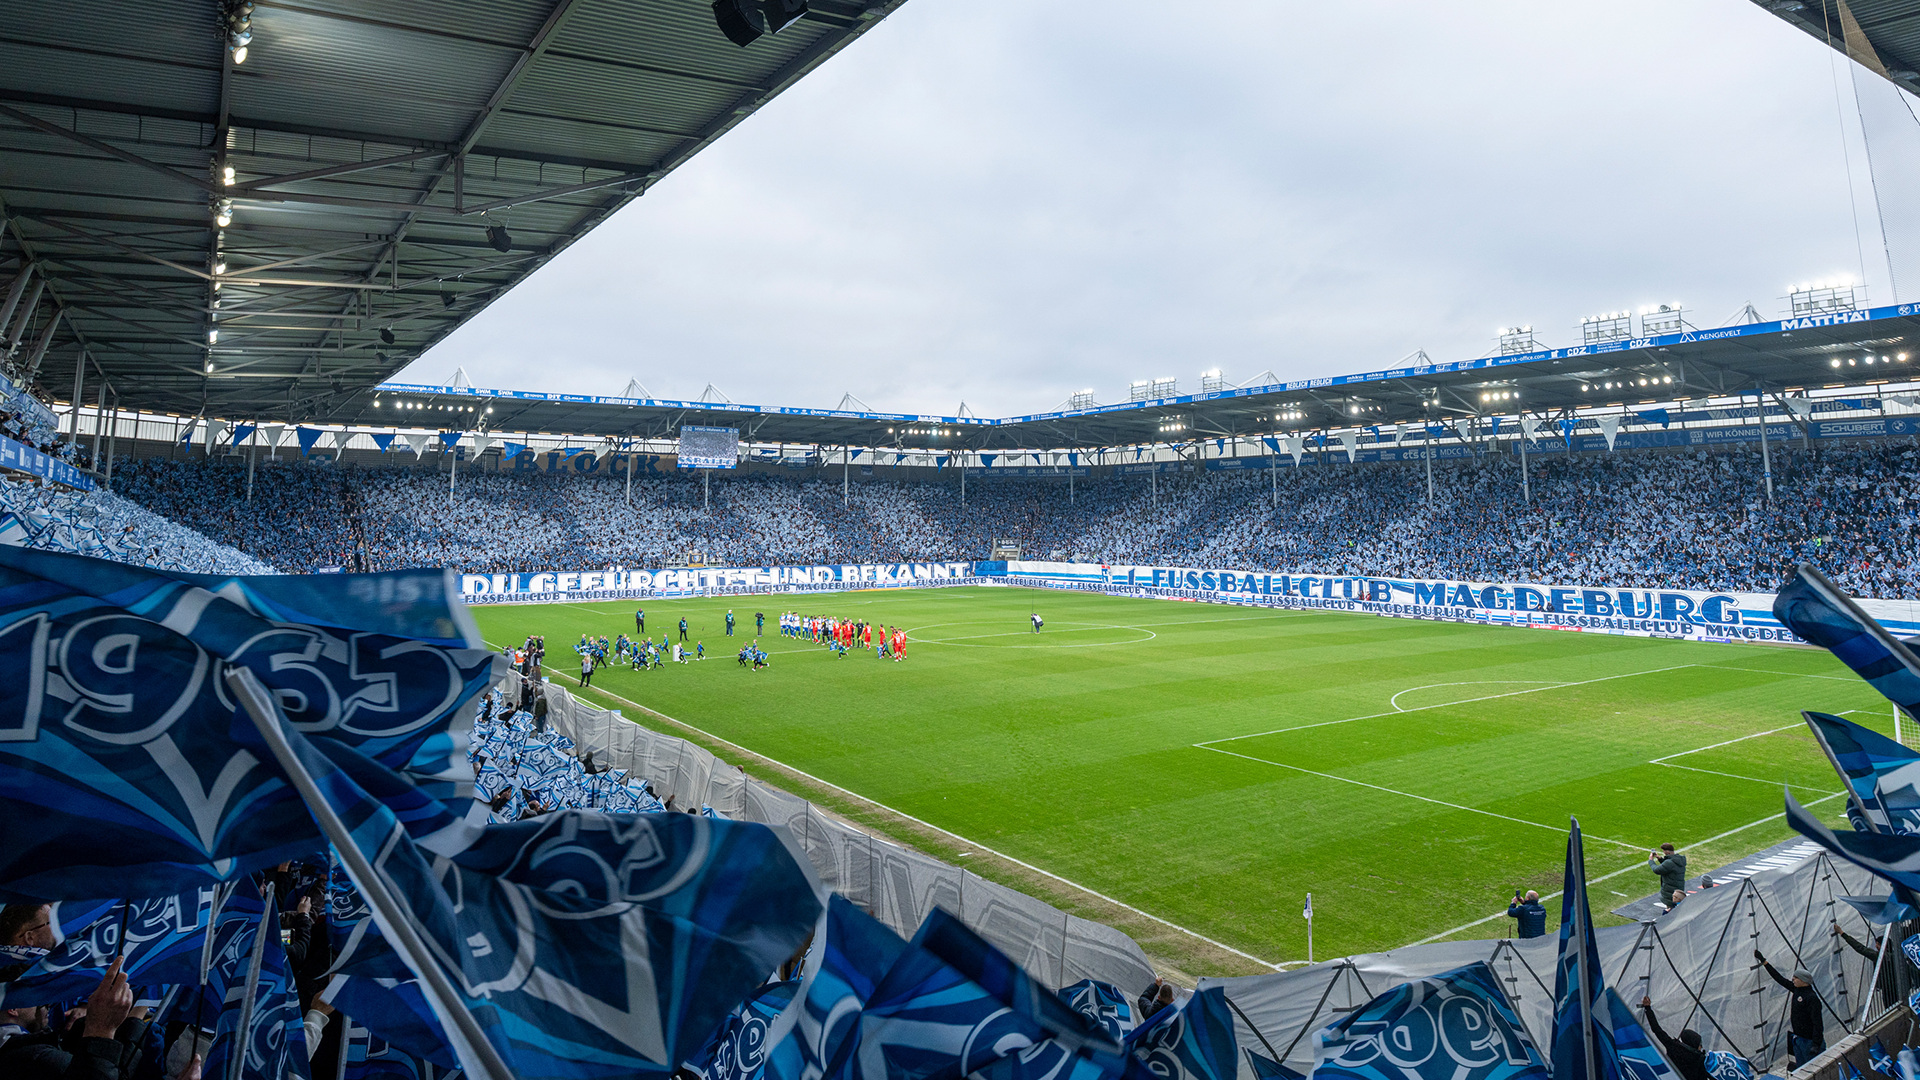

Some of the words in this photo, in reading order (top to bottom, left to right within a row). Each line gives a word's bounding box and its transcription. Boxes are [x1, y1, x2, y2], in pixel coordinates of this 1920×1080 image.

[1699, 329, 1741, 340] AENGEVELT
[1629, 339, 1651, 349] CDZ
[1567, 347, 1587, 357] CDZ
[1499, 353, 1546, 364] www.kk-office.com
[1706, 431, 1723, 439] WIR
[1725, 428, 1762, 438] KÖNNEN
[1766, 427, 1788, 435] DAS.
[1820, 423, 1884, 433] SCHUBERT
[1402, 450, 1419, 460] ets
[1440, 447, 1461, 456] MDCC
[515, 450, 661, 475] BLOCK
[463, 574, 521, 595] DU
[841, 562, 971, 583] BEKANNT
[916, 577, 987, 588] FUSSBALLCLUB
[702, 584, 791, 597] FUSSBALLCLUB
[1078, 582, 1140, 595] FUSSBALLCLUB
[465, 591, 560, 604] FUSSBALLCLUB
[1152, 569, 1394, 602] FUSSBALLCLUB
[1413, 581, 1744, 624] MAGDEBURG
[1262, 595, 1355, 610] FUSSBALLCLUB
[1543, 613, 1694, 635] FUSSBALLCLUB
